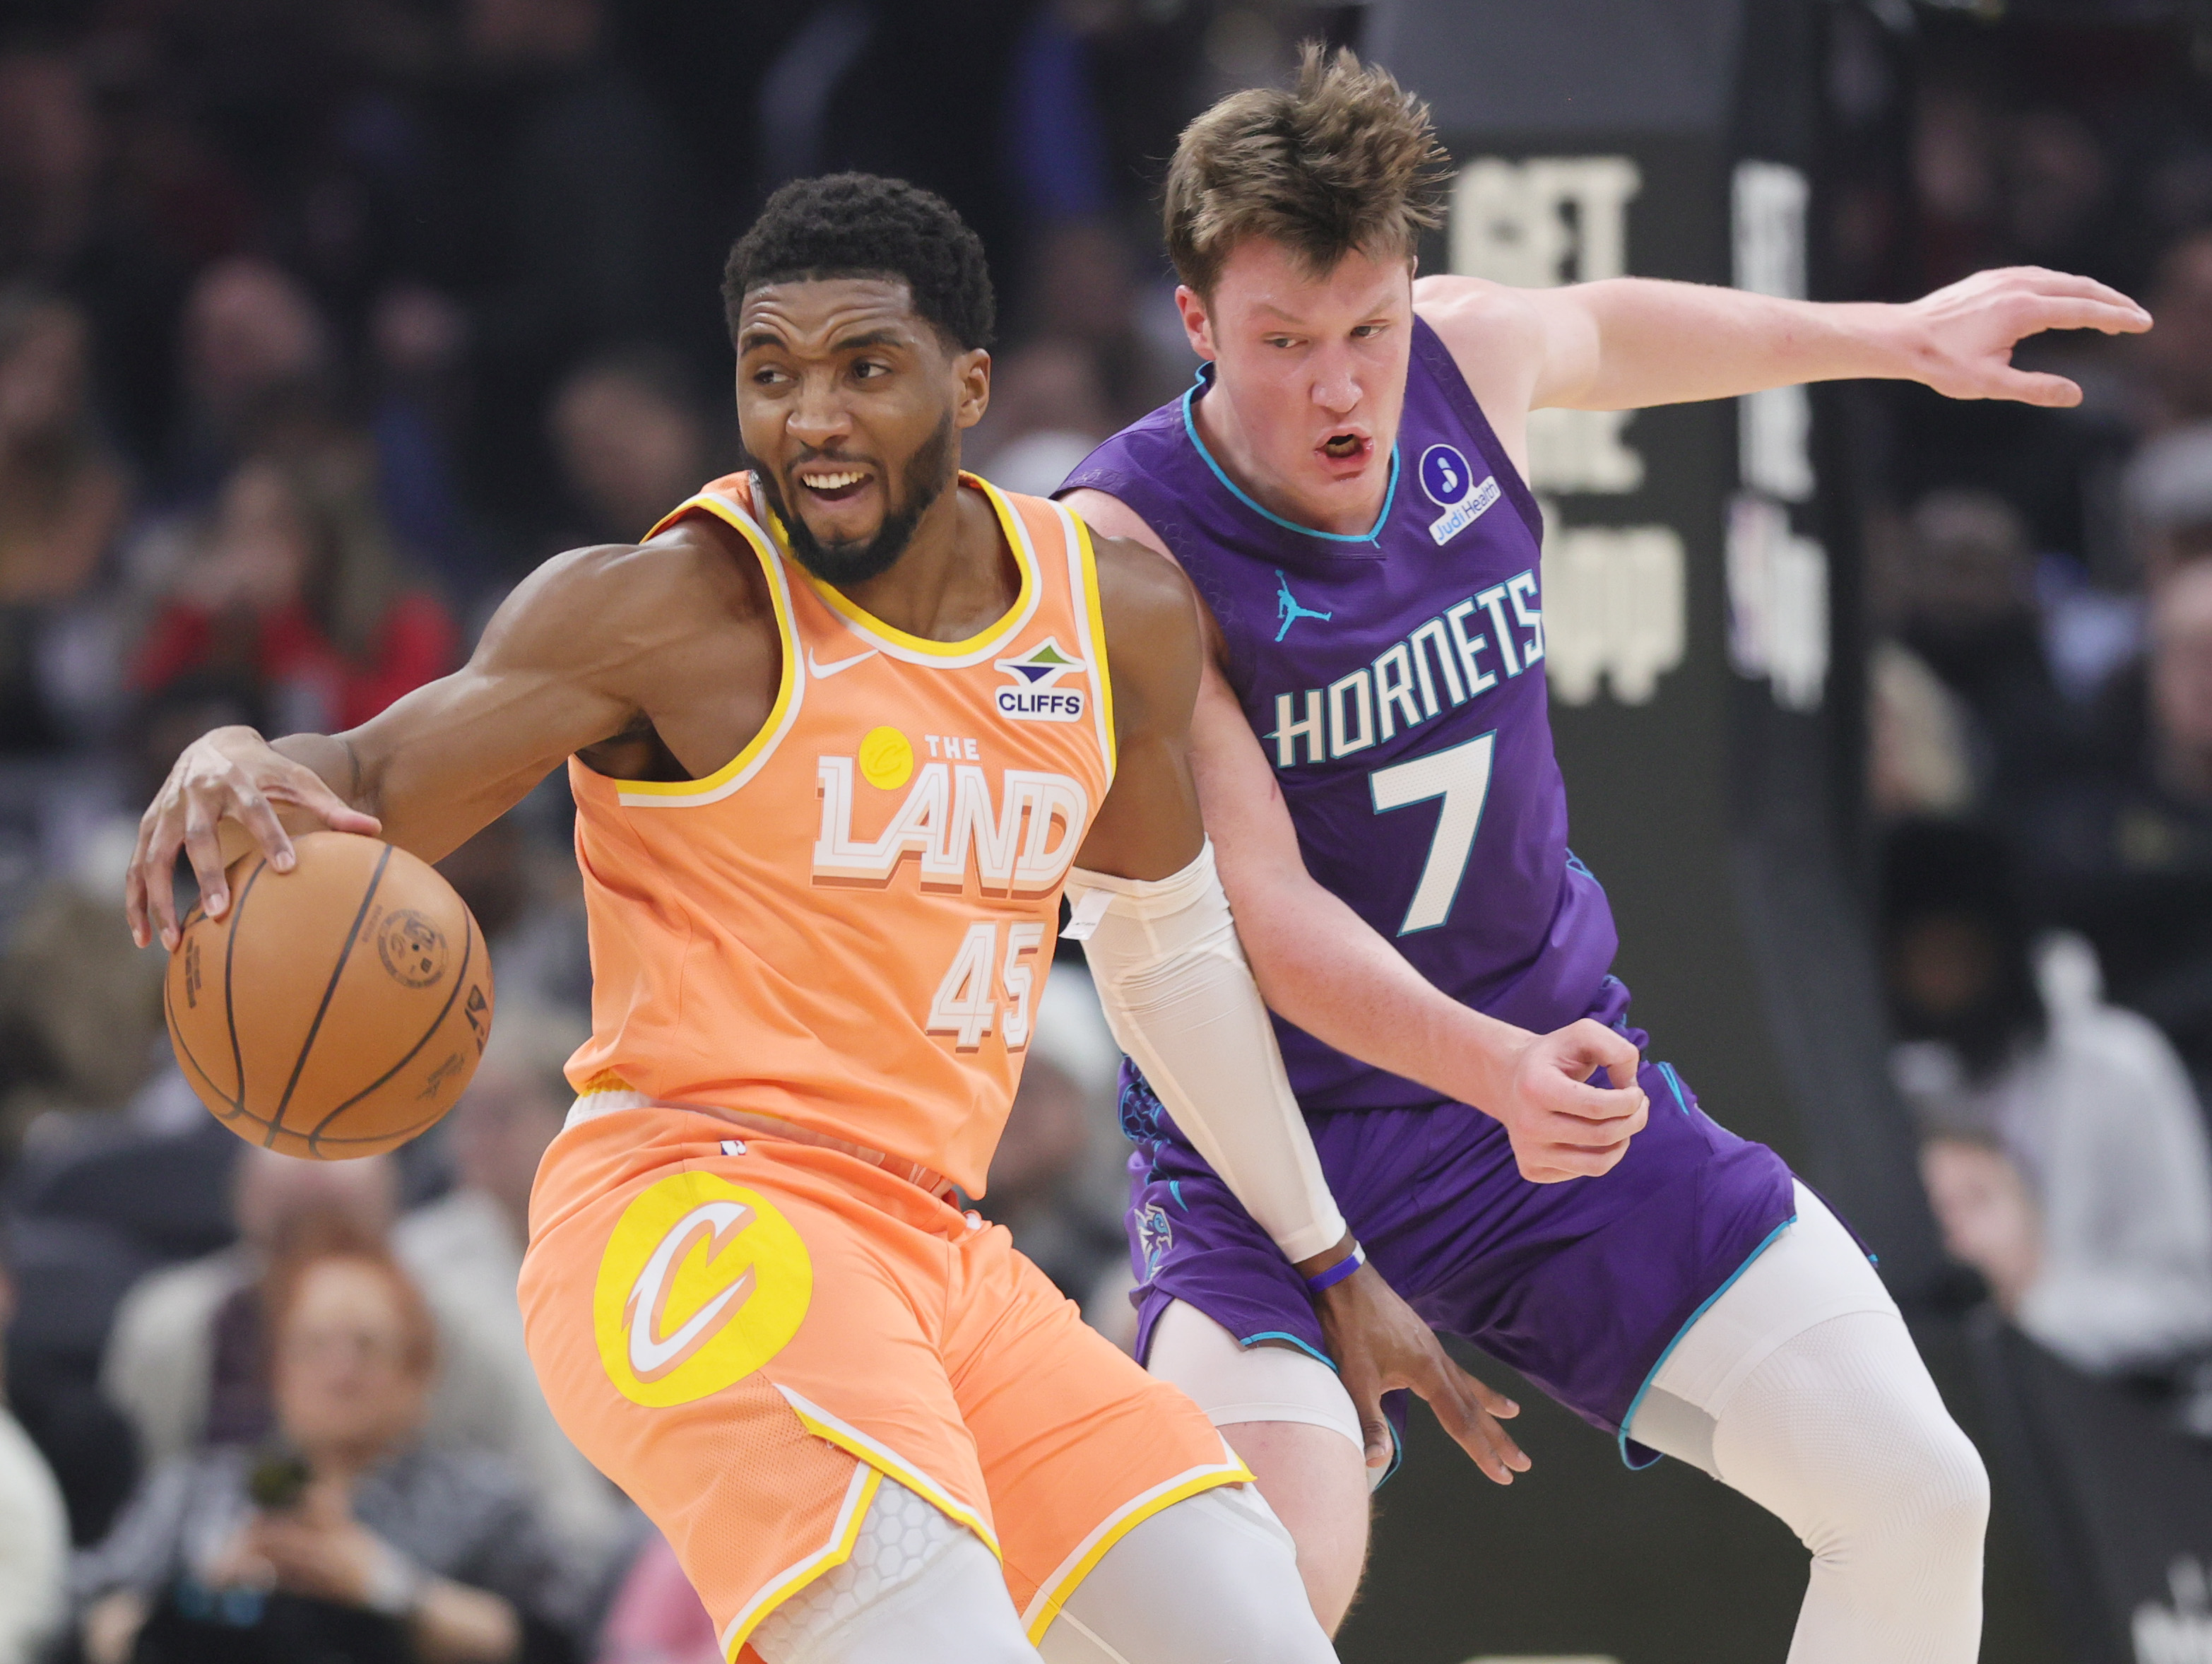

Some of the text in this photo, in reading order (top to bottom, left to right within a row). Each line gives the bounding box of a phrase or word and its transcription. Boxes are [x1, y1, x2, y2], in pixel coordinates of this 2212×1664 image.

[1436, 480, 1498, 541] Judi Health
[998, 692, 1080, 715] CLIFFS
[1263, 568, 1545, 768] HORNETS
[924, 734, 981, 761] THE
[810, 754, 1089, 901] LAND
[1368, 728, 1498, 937] 7
[925, 921, 1045, 1054] 45
